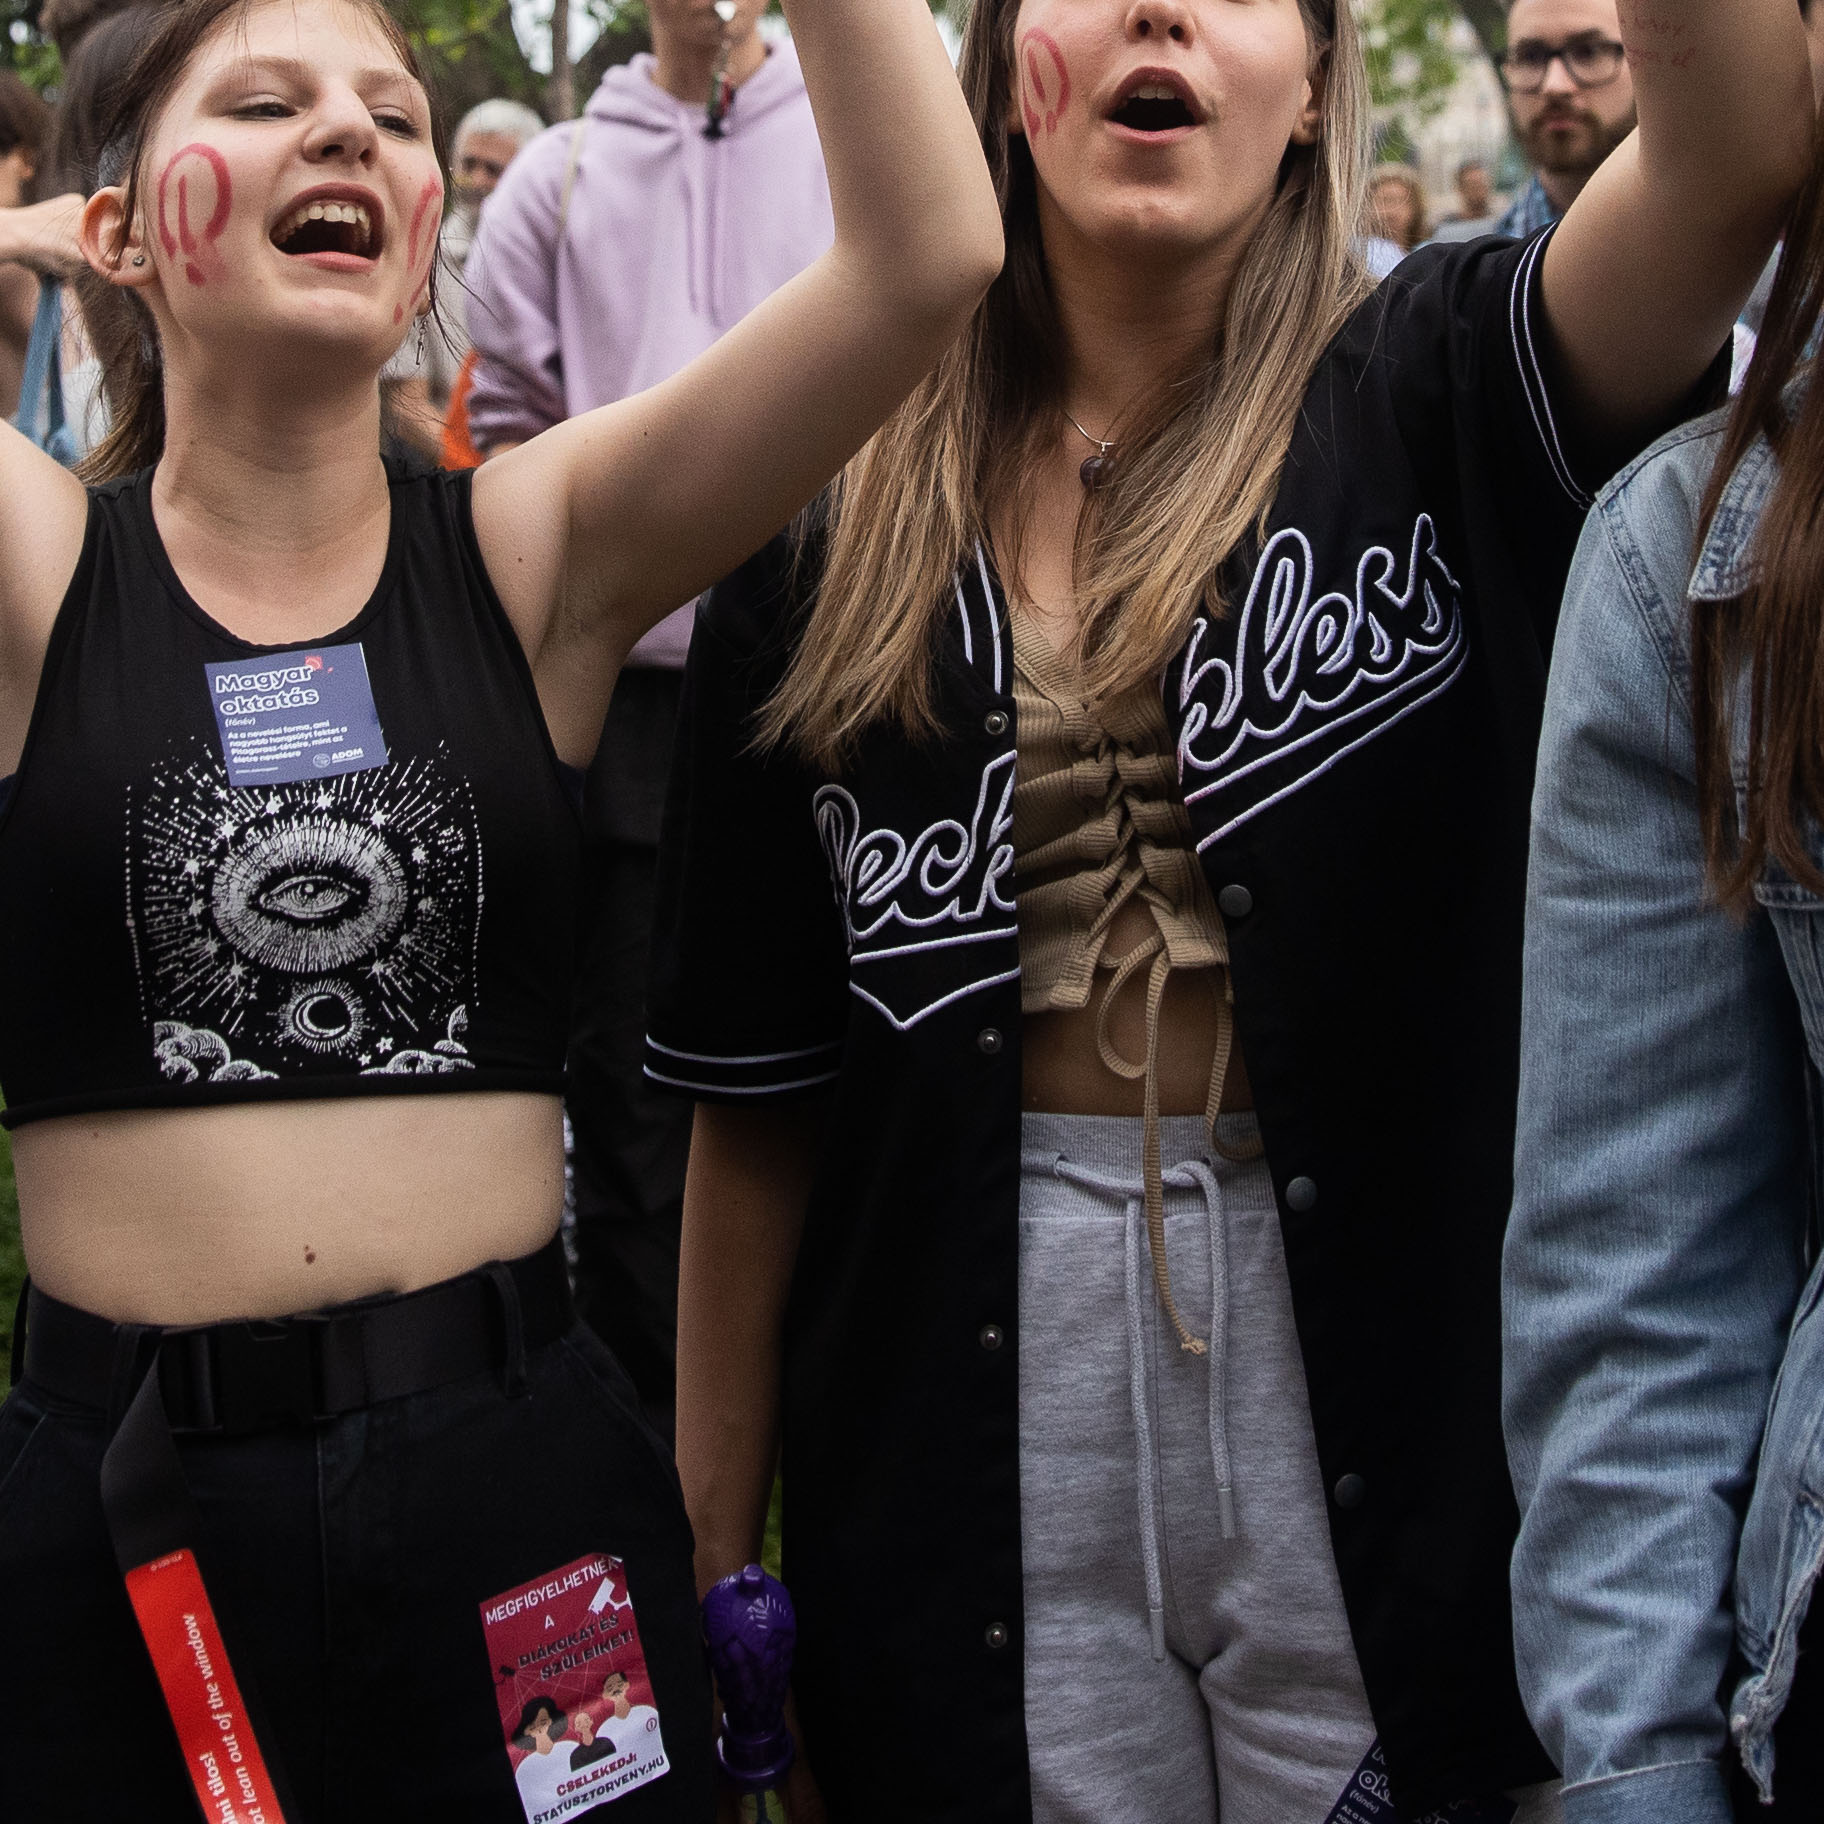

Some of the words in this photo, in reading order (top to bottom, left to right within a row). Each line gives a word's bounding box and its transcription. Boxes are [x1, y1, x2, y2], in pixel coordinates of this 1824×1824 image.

[216, 666, 312, 693] Magyar
[220, 688, 319, 715] oktatás
[332, 747, 363, 760] ADOM
[544, 1615, 555, 1629] A
[183, 1612, 214, 1680] window
[518, 1623, 595, 1668] DIÁKOKAT
[600, 1614, 619, 1631] ÉS
[540, 1628, 634, 1681] SZÜLEIKET!
[206, 1681, 225, 1709] the
[212, 1712, 232, 1731] of
[222, 1732, 242, 1763] out
[199, 1750, 225, 1797] tilos!
[236, 1766, 257, 1805] lean
[533, 1755, 665, 1824] STATUSZTORVENY.HU
[249, 1806, 266, 1824] ot
